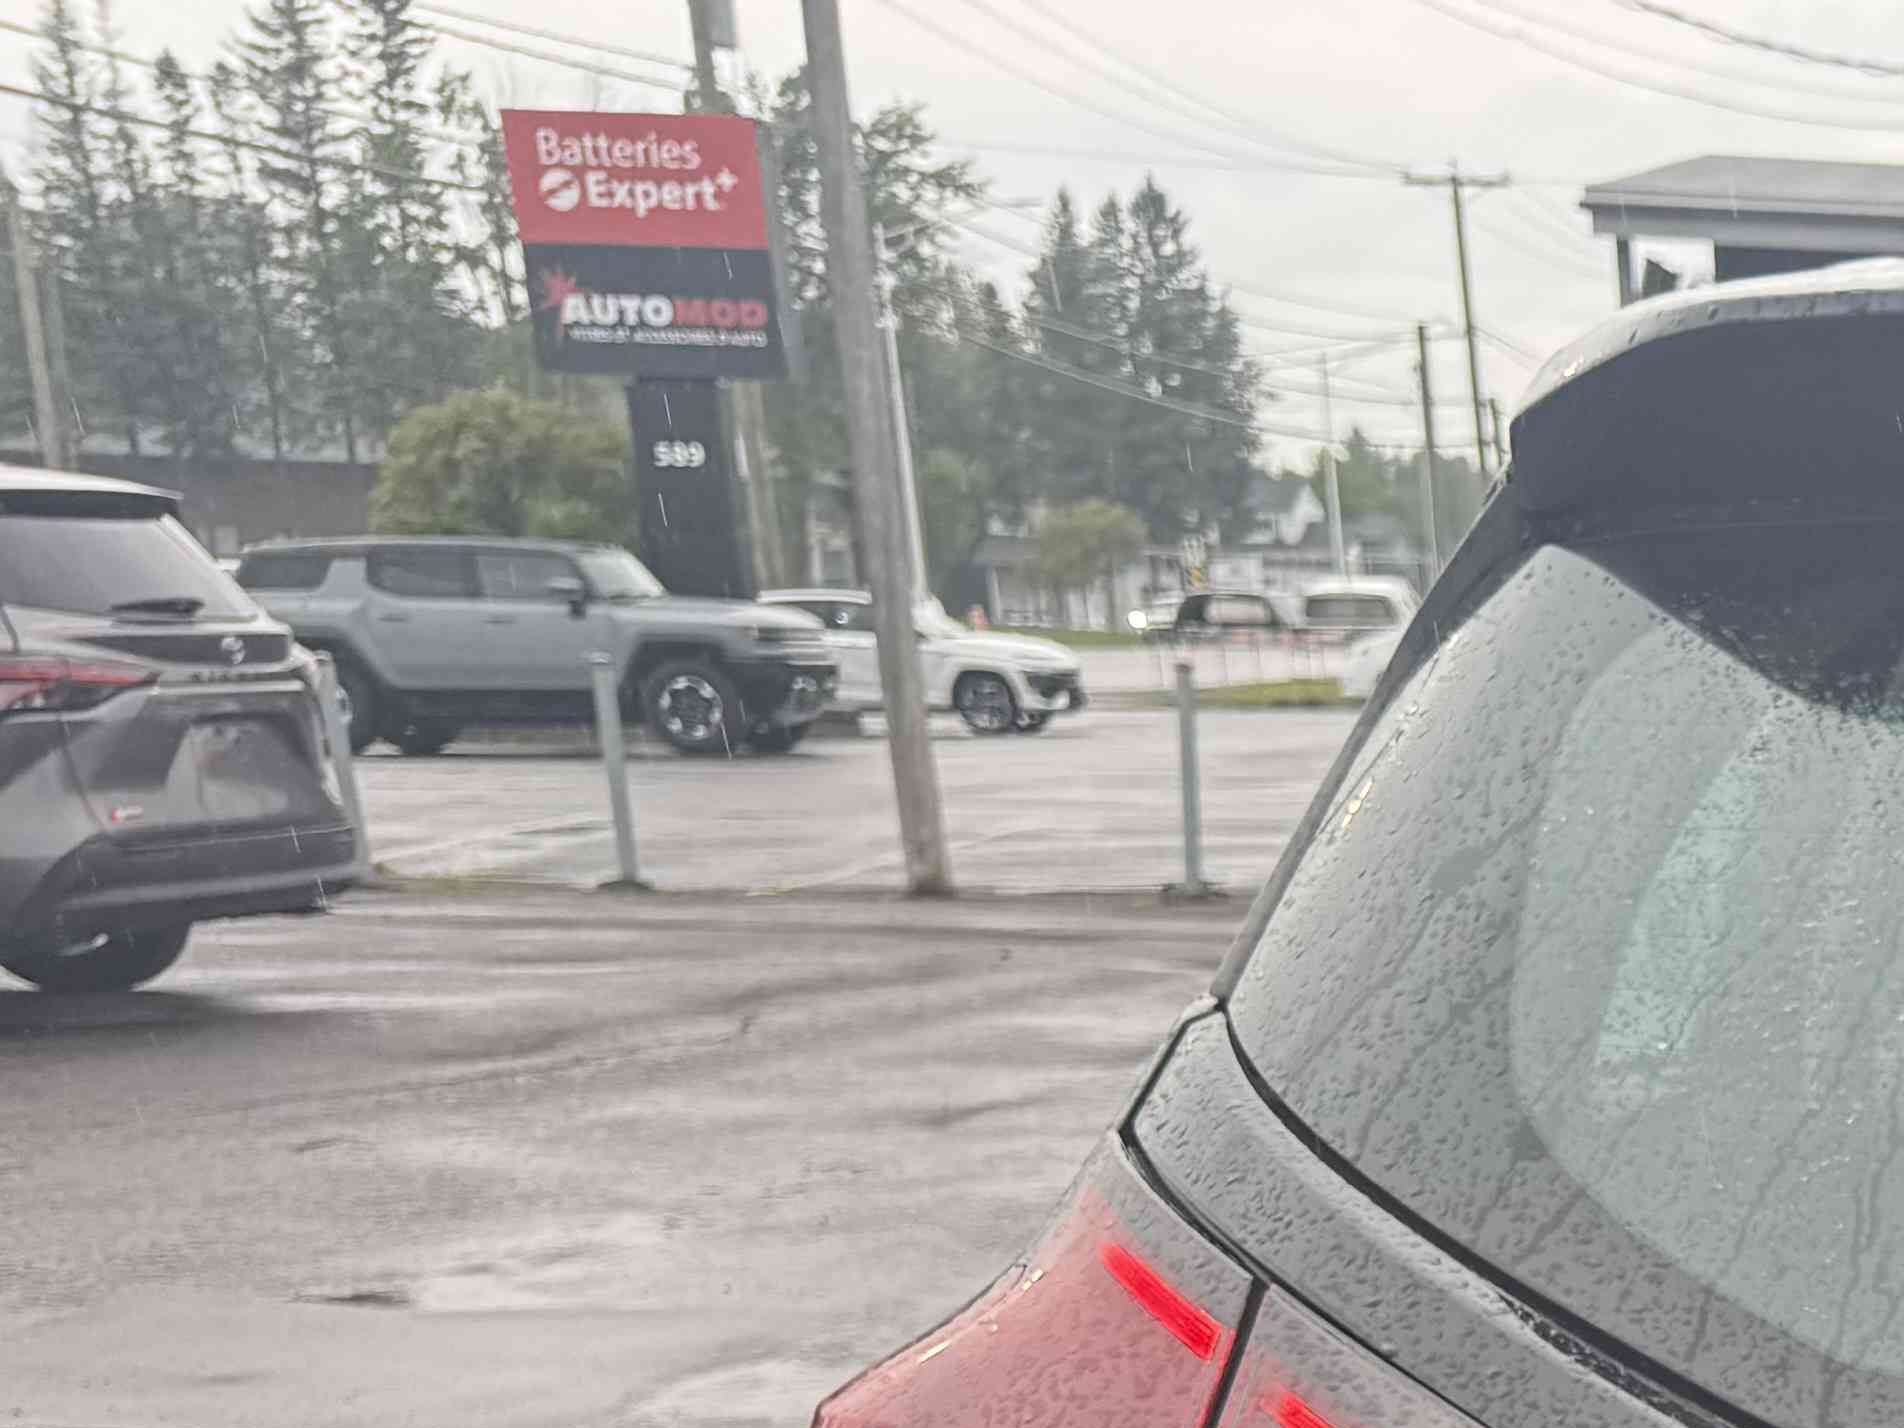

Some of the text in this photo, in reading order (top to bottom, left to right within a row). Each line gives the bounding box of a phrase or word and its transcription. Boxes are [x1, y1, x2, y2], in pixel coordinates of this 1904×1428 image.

[536, 127, 701, 170] Batteries
[562, 293, 768, 327] AUTOMOD
[652, 440, 706, 468] 589
